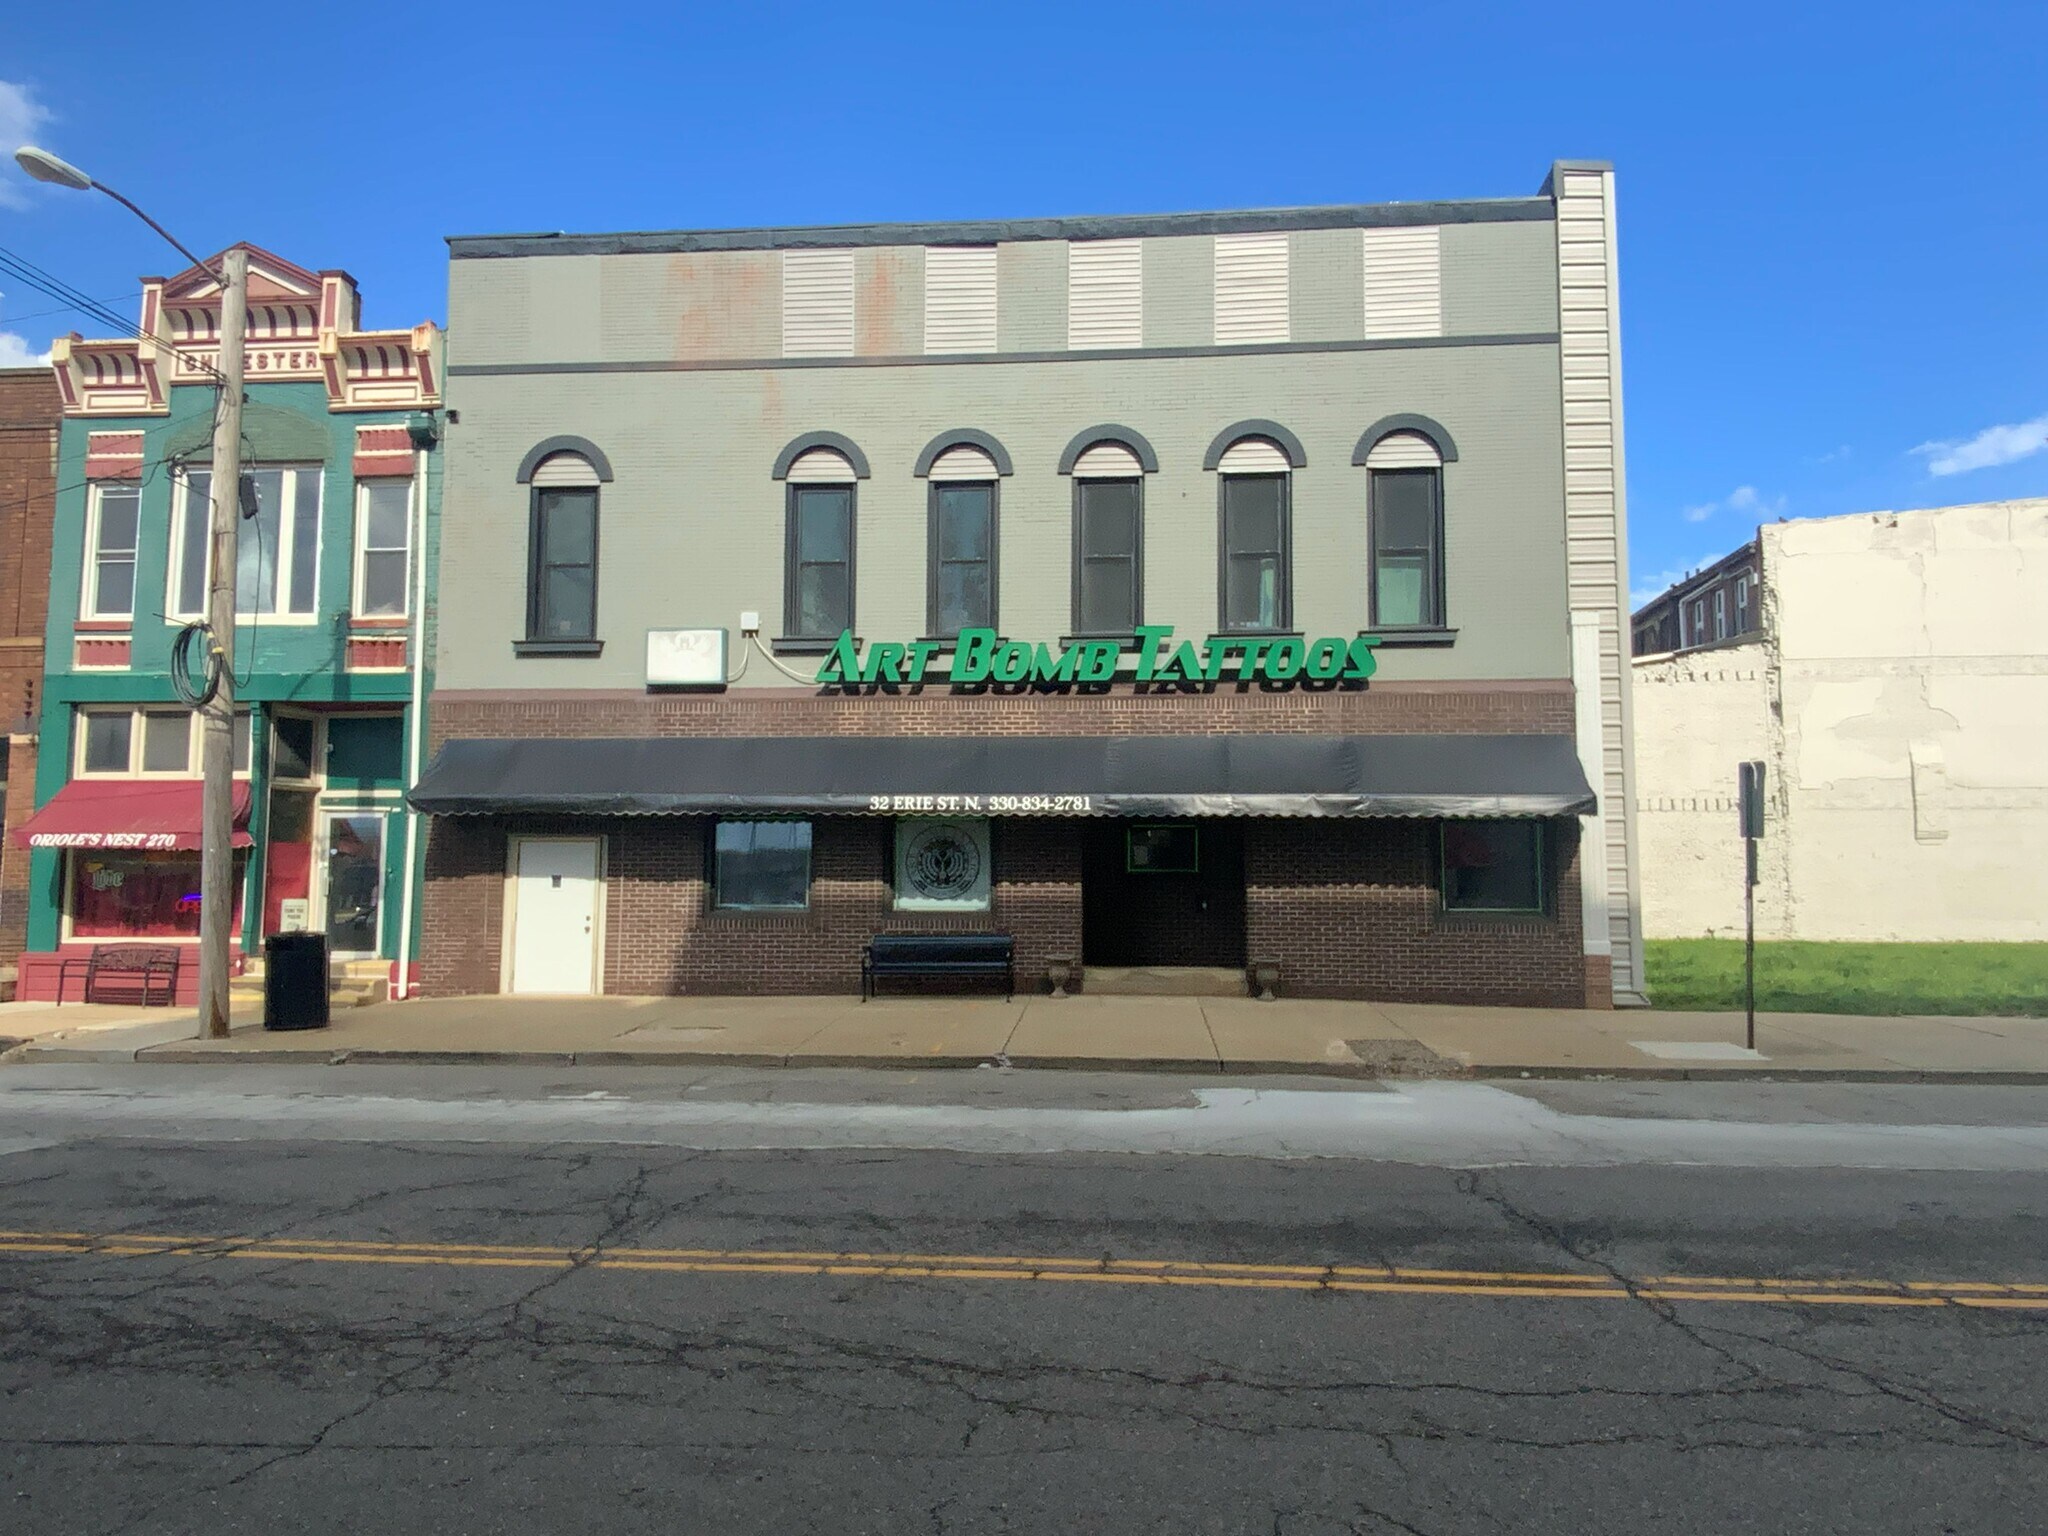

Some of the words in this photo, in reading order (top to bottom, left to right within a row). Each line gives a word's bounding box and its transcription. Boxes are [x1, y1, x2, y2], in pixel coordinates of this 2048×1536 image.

[815, 628, 940, 682] ART
[950, 627, 1120, 682] BOMB
[1135, 625, 1382, 681] TATTOOS
[869, 796, 889, 810] 32
[893, 796, 934, 810] ERIE
[937, 796, 960, 810] ST.
[964, 796, 982, 810] N.
[989, 796, 1092, 811] 330-834-2781
[29, 833, 102, 847] ORIOLE'S
[102, 833, 145, 846] NEST
[146, 833, 177, 847] 270
